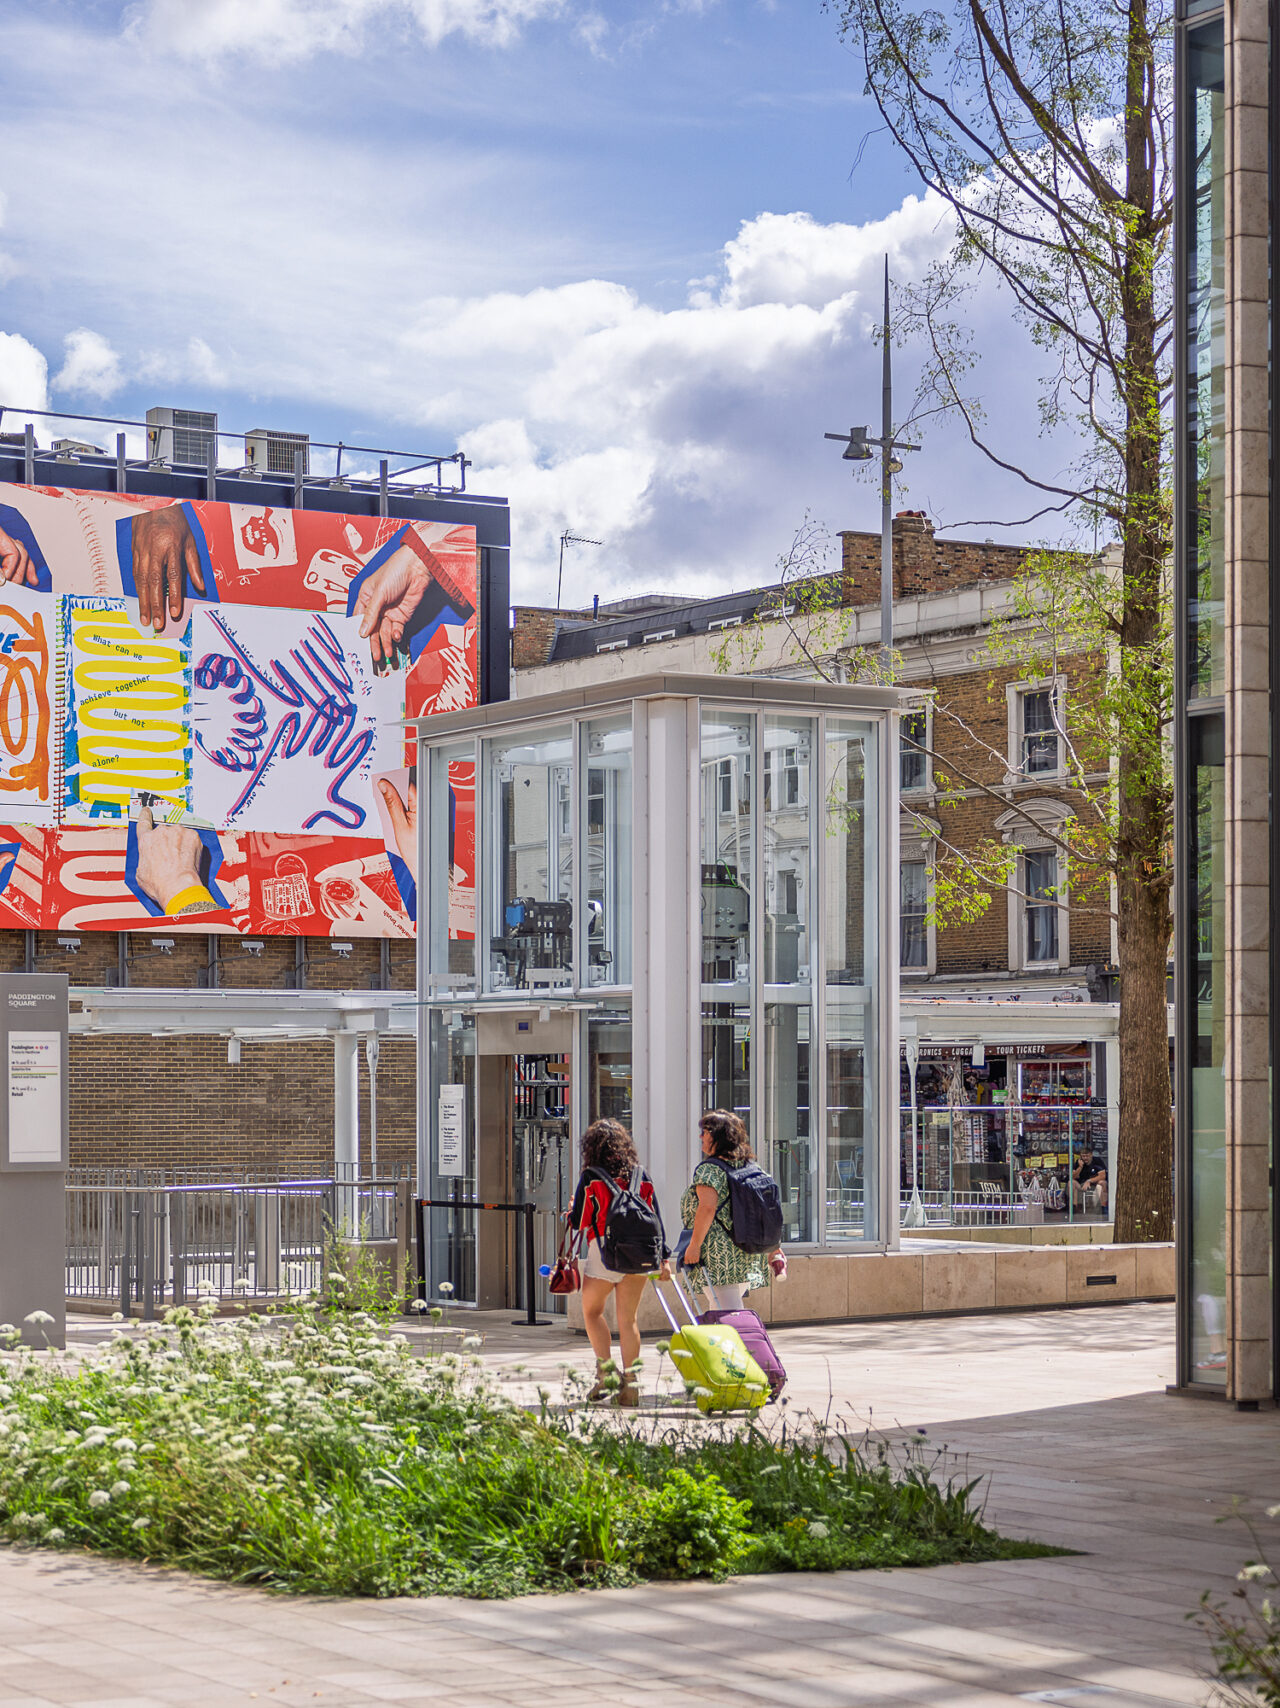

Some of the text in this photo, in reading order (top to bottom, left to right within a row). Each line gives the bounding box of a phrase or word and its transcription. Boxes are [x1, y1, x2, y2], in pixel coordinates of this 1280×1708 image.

[92, 634, 143, 661] What can we
[80, 675, 151, 706] achieve together
[113, 709, 146, 728] but not
[92, 754, 120, 768] alone?
[383, 910, 397, 926] brush
[8, 1000, 37, 1008] SQUARE
[900, 1047, 942, 1057] ELRONICS
[996, 1046, 1014, 1055] TOUR
[1016, 1045, 1046, 1054] TICKETS
